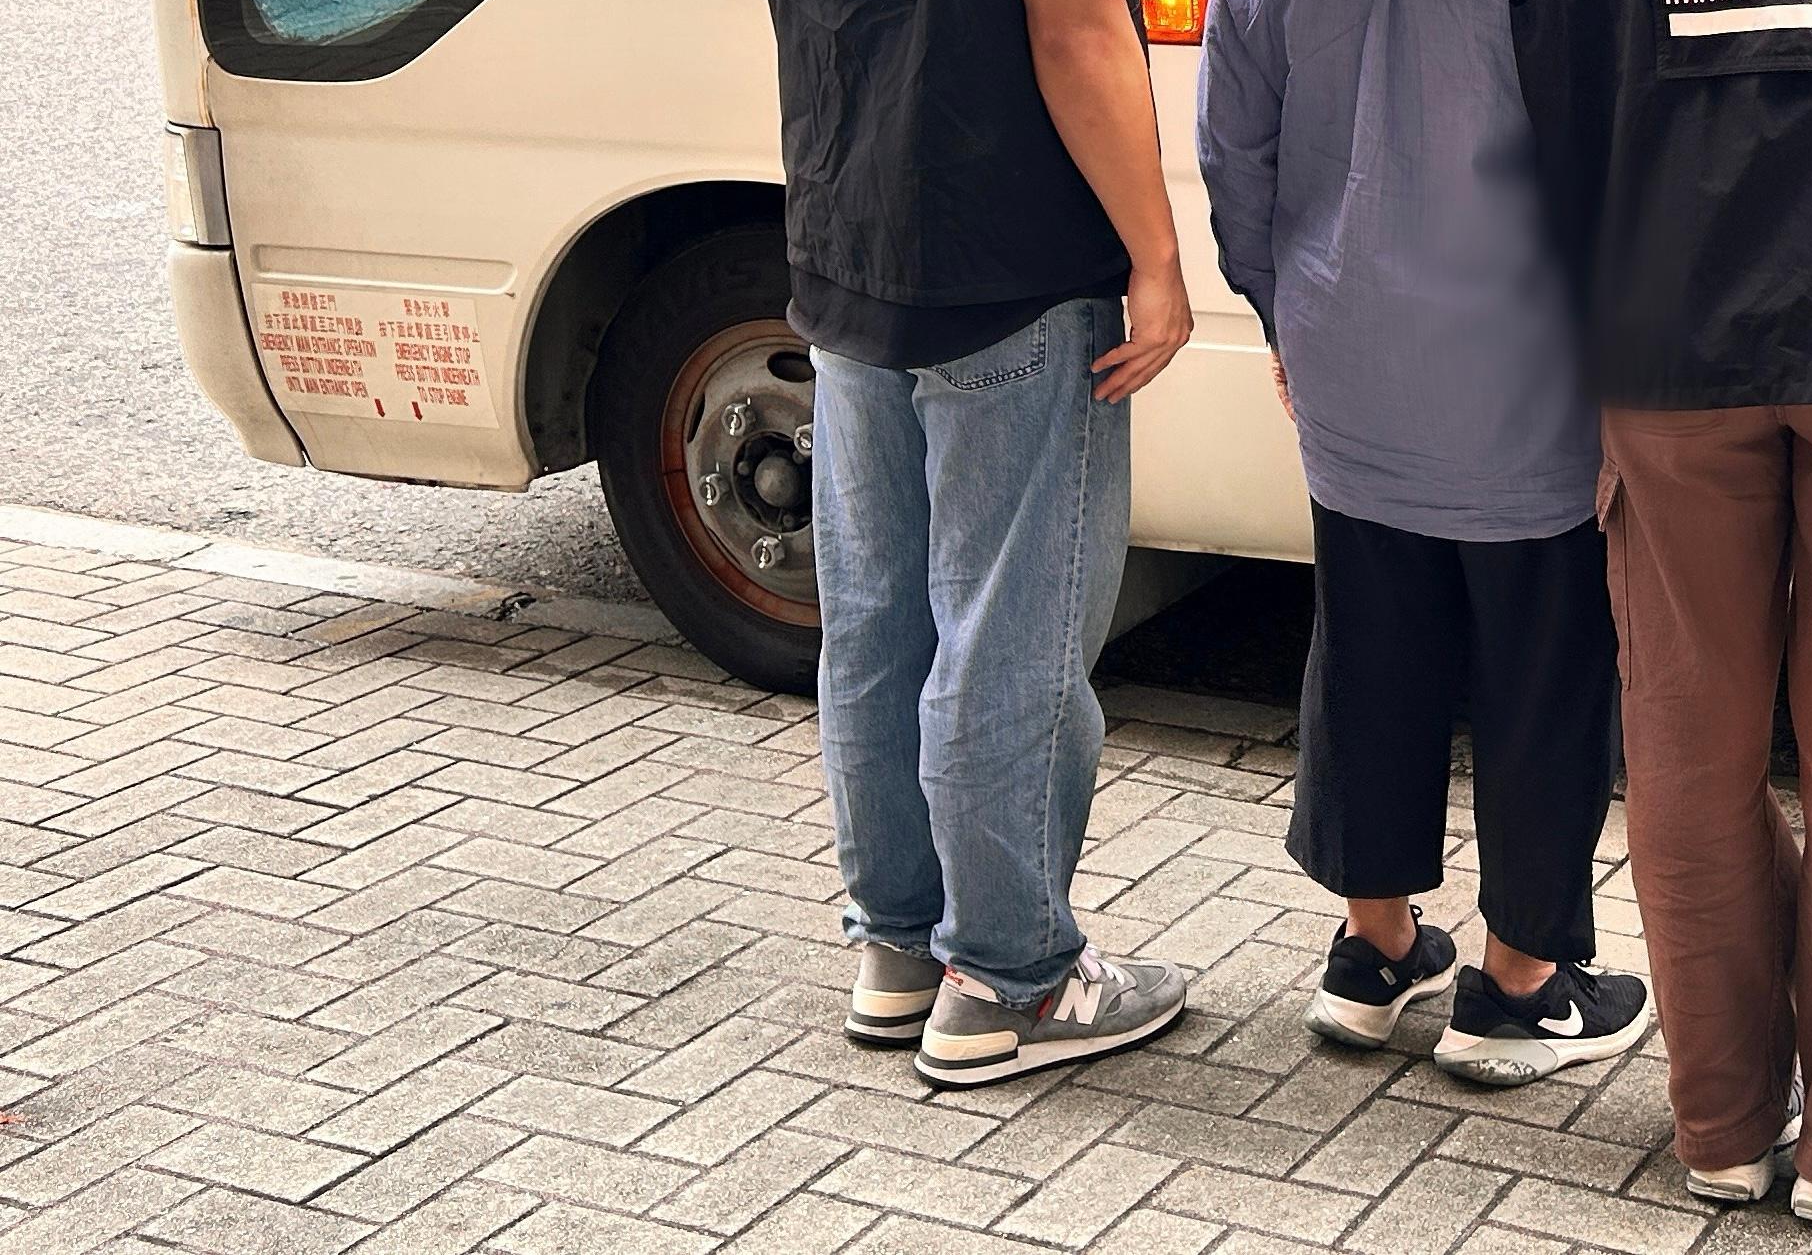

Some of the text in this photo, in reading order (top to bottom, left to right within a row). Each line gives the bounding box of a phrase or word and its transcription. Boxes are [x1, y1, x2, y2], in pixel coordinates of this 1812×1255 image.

[280, 354, 300, 373] PRESS
[300, 356, 325, 374] BUTTON
[454, 346, 471, 365] STOP
[395, 363, 416, 382] PRESS
[415, 365, 441, 383] BUTTON
[417, 385, 428, 403] TO
[428, 387, 445, 404] STOP
[1053, 977, 1103, 1025] N
